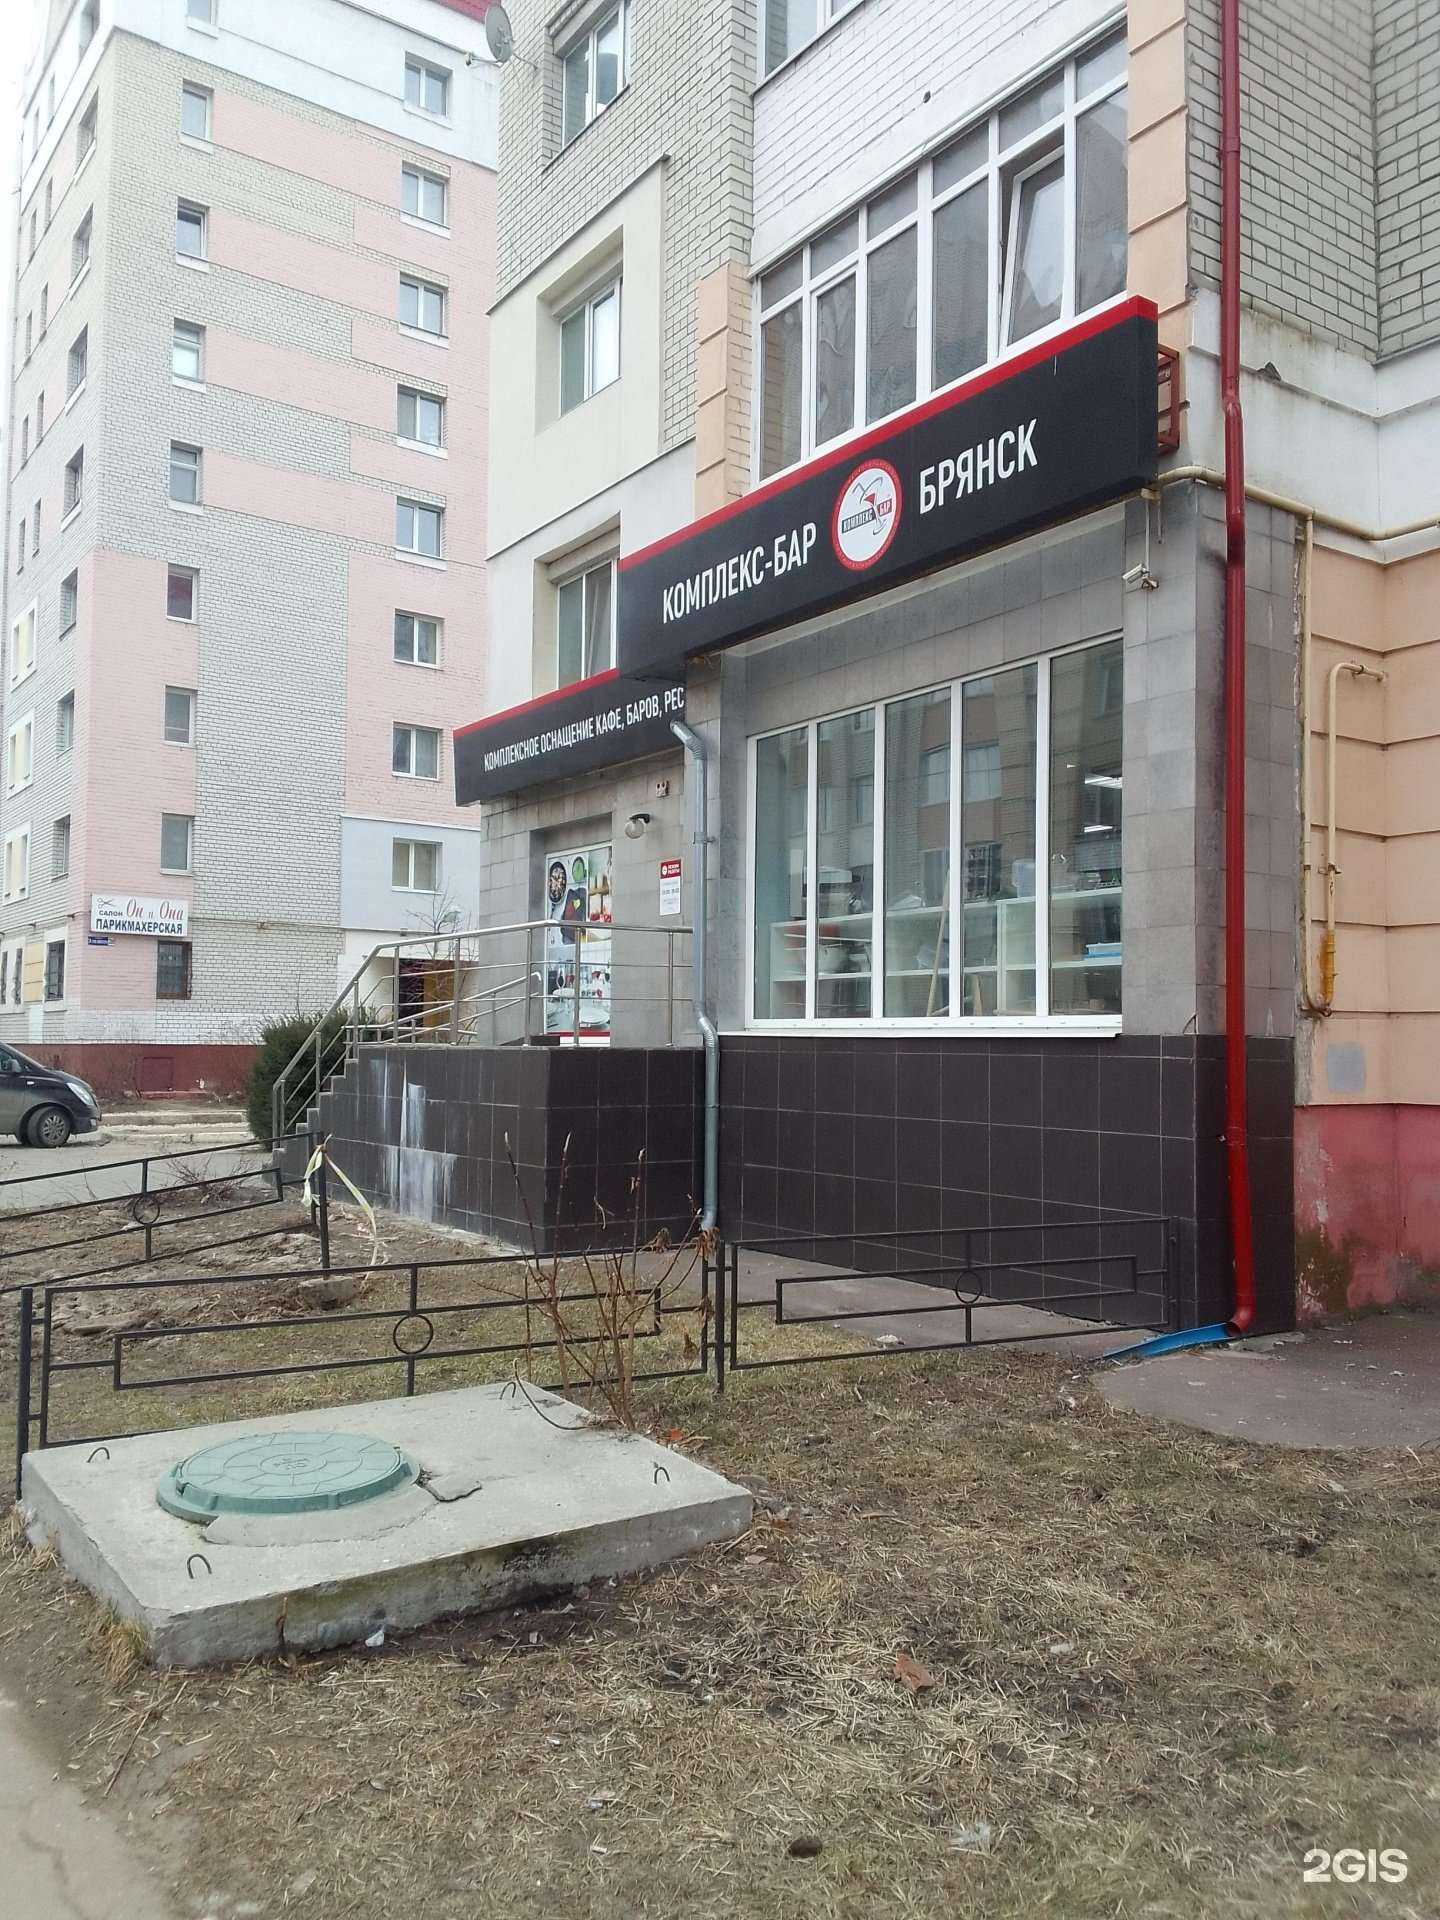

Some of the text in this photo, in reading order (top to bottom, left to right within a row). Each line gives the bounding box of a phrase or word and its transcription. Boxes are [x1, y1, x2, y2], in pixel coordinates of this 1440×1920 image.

[662, 418, 1038, 624] КОМПЛЕКС-БАР БРЯНСК
[484, 736, 539, 772] КОМПЛЕКСНОЕ
[540, 717, 595, 752] ОСНАЩЕНИЕ
[596, 708, 625, 735] КАФЕ,
[626, 695, 663, 724] БАРОВ,
[95, 918, 183, 934] ПАРИКМАХЕРСКАЯ
